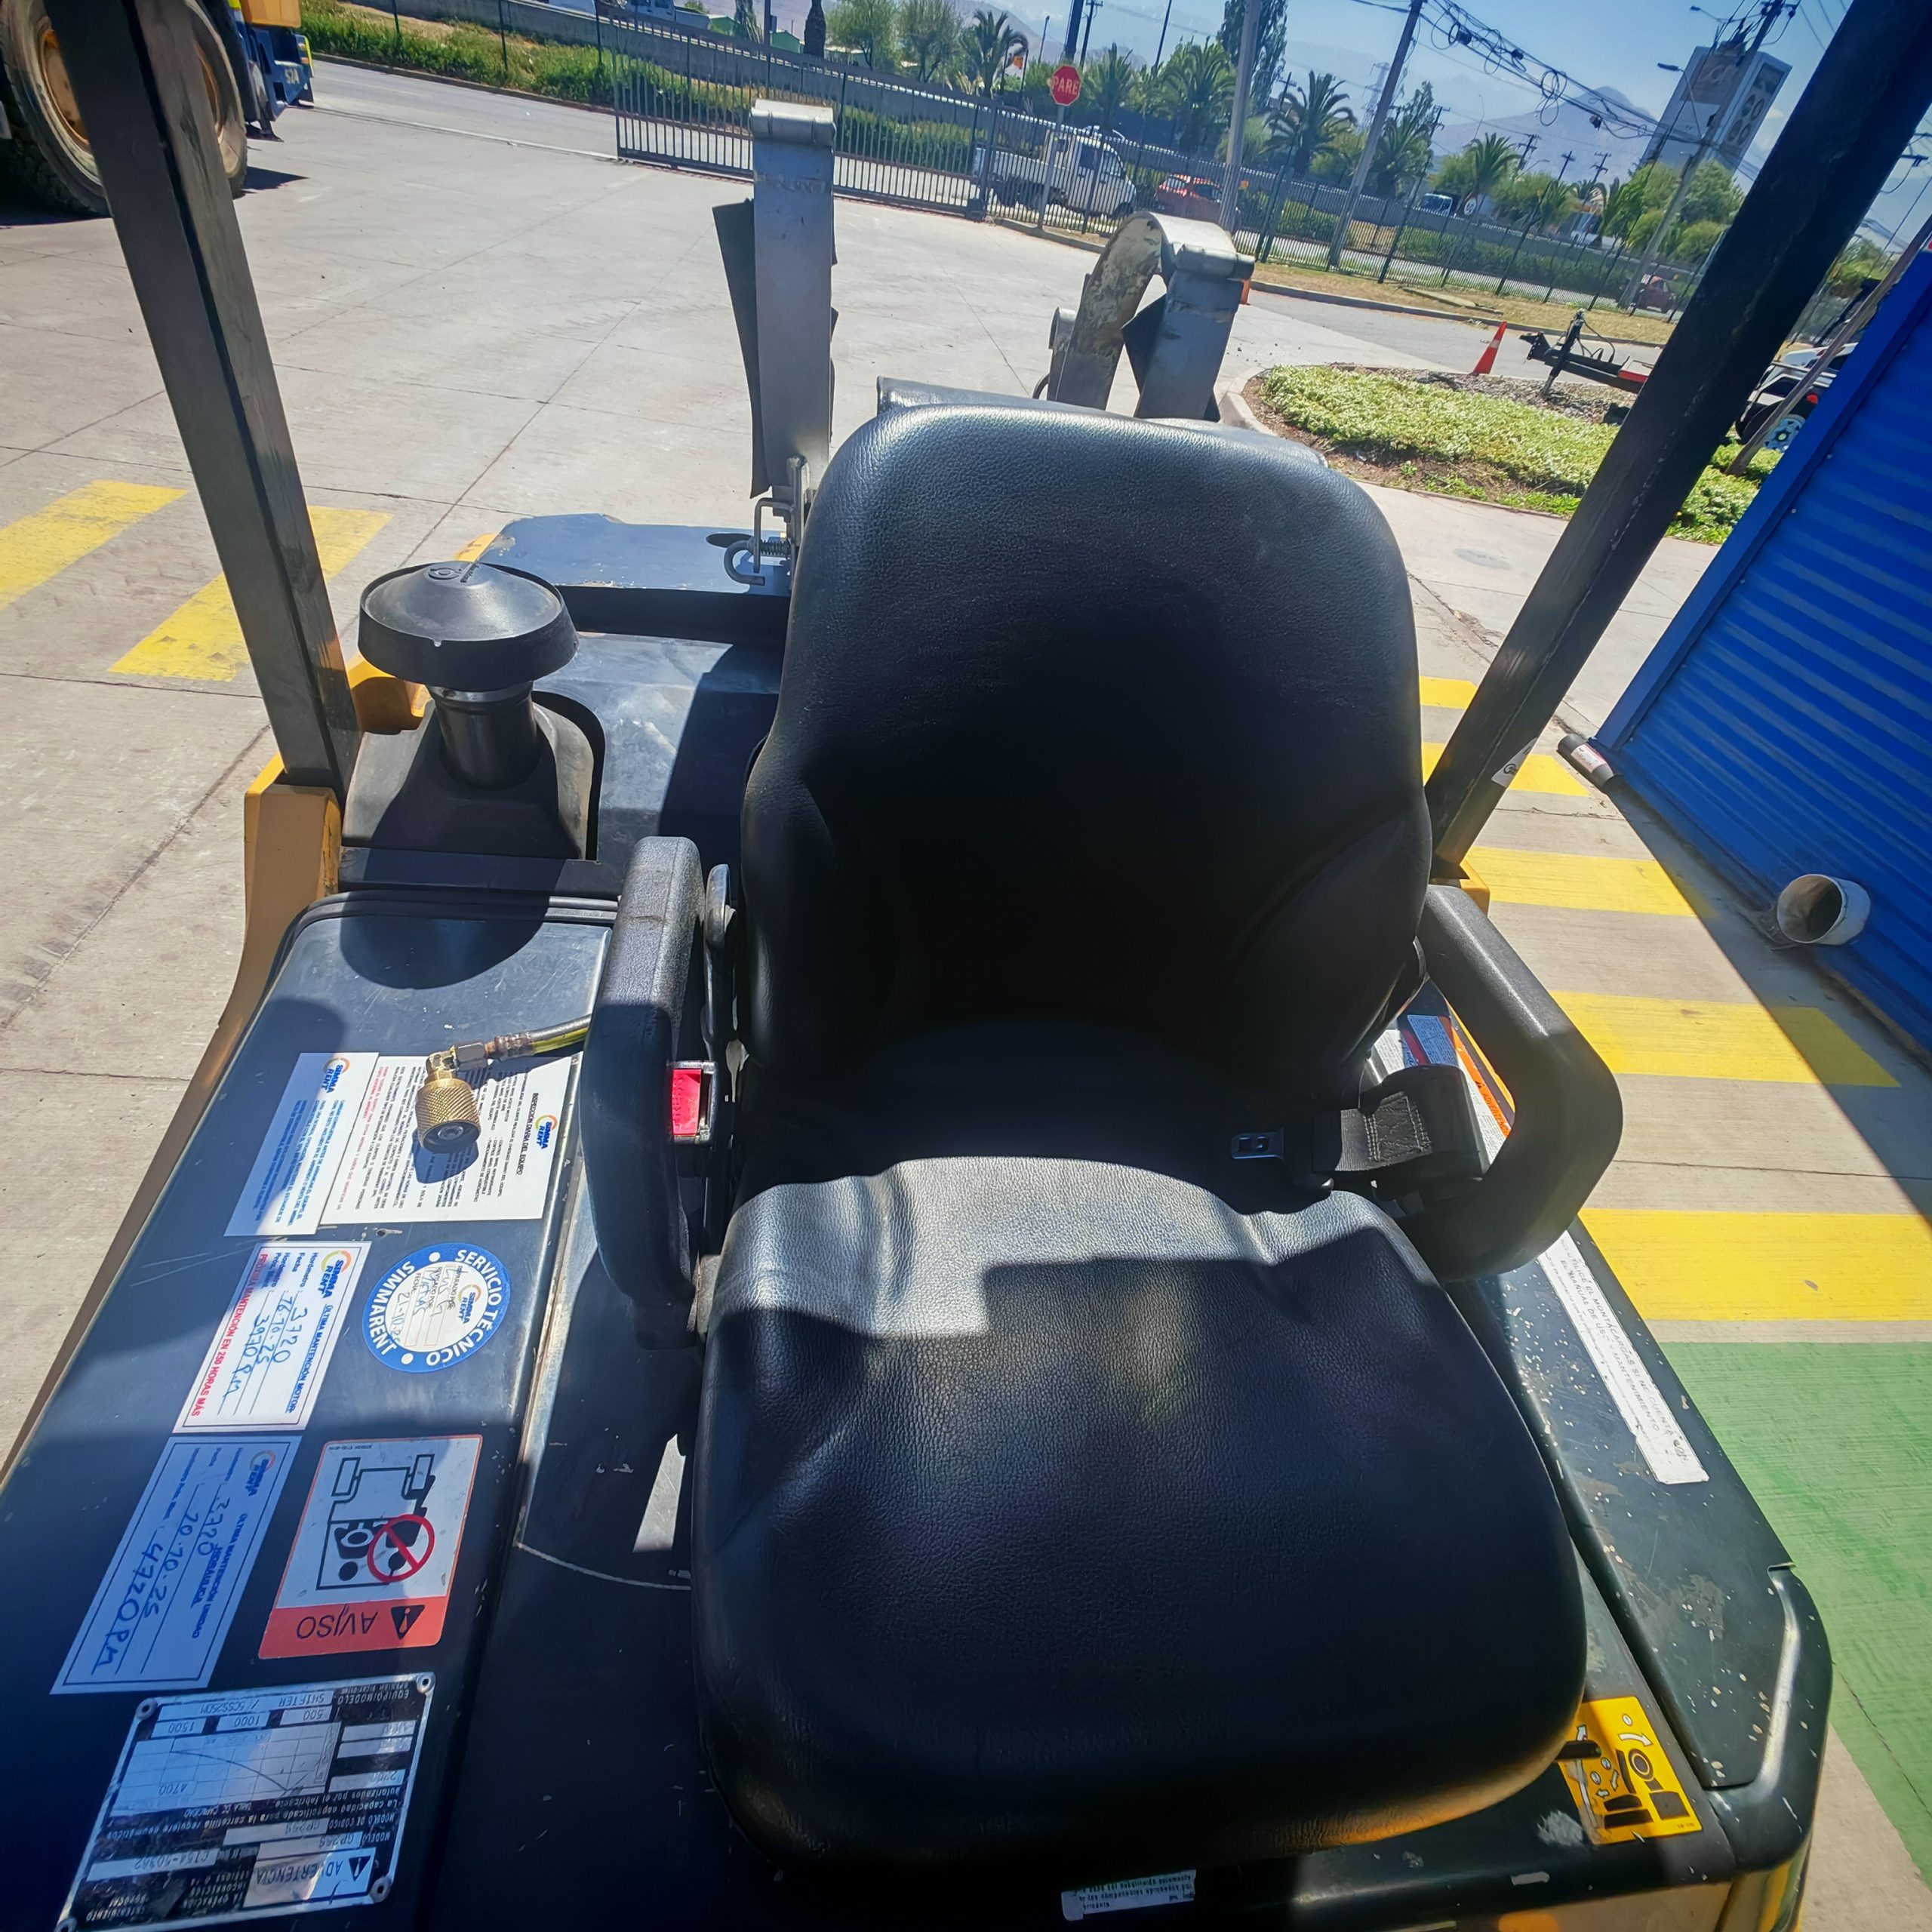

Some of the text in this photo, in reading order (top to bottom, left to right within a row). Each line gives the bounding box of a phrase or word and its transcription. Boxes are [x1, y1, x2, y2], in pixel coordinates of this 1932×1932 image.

[1052, 75, 1079, 95] PARE
[320, 1069, 334, 1090] RENT
[325, 1064, 343, 1093] SIMMA
[520, 1142, 528, 1152] DEL
[522, 1124, 532, 1141] DIARIA
[534, 1125, 546, 1146] RENT
[539, 1121, 553, 1149] SIMMA
[515, 1154, 526, 1175] EQUIPO
[291, 1252, 305, 1272] Fecha
[298, 1252, 318, 1287] Horómetro
[315, 1265, 334, 1294] RENT
[321, 1260, 344, 1298] SIMMA
[368, 1261, 414, 1355] SIMMARENT
[426, 1249, 502, 1365] SERVICIO TÉCNICO
[457, 1297, 469, 1321] RENT
[463, 1291, 475, 1324] SIMMA
[189, 1254, 269, 1416] PRÓXIMA MANTENCIÓN EN 250 HORAS MÁS
[238, 1314, 273, 1356] 3970
[270, 1306, 309, 1363] 3720
[1592, 1296, 1636, 1366] MONTACARGAS
[286, 1305, 334, 1412] ÚLTIMA MANTENCIÓN MOTOR
[109, 1543, 168, 1621] 4720
[190, 1513, 248, 1638] ÚLTIMA MANTENCIÓN UNIDAD
[292, 1606, 380, 1640] AVISO
[277, 1693, 326, 1706] SHIFTER
[232, 1715, 261, 1727] 1000
[301, 1709, 325, 1720] 500
[251, 1860, 343, 1887] ADVERTENCIA
